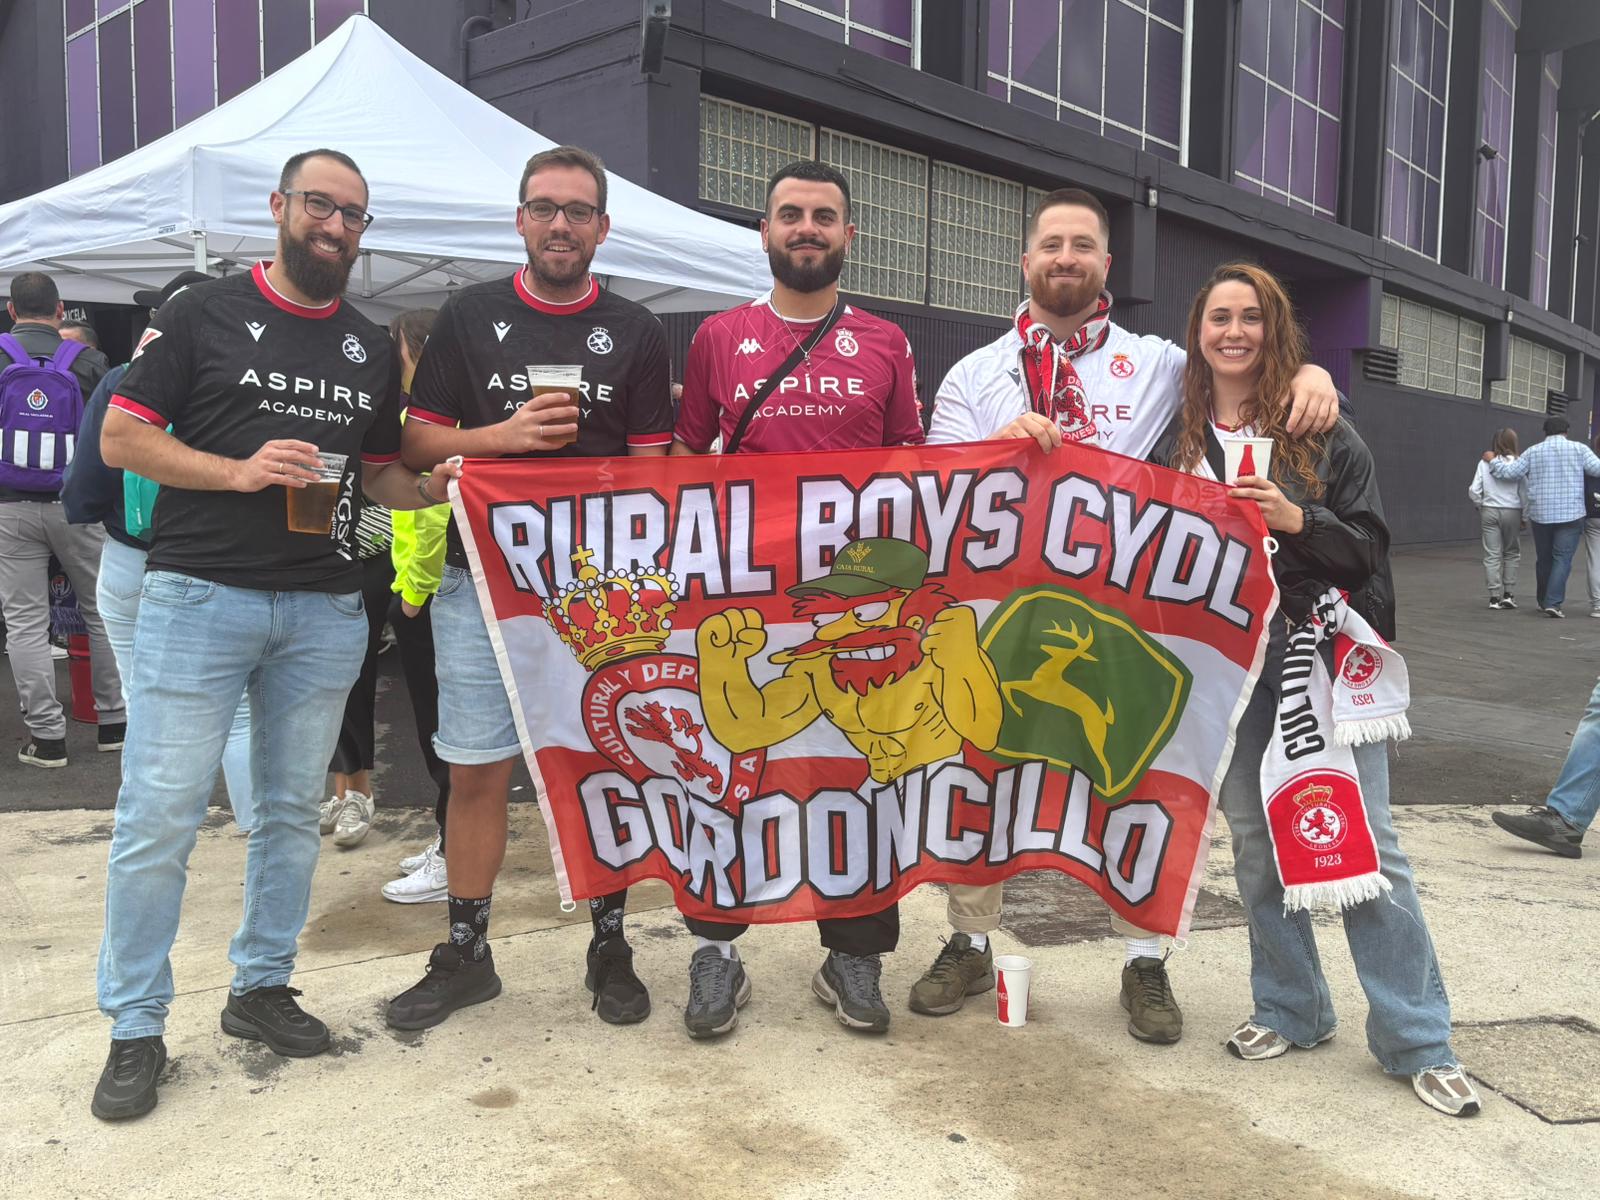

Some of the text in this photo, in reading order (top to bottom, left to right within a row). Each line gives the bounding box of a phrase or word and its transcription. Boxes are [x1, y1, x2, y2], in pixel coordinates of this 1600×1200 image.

[239, 368, 372, 411] ASPIRE
[487, 373, 613, 402] ASRE
[258, 399, 354, 426] ACADEMY
[752, 404, 846, 421] ACADEMY
[488, 482, 776, 601] RURAL
[797, 467, 1028, 585] BOYS
[1041, 471, 1254, 633] CYDL
[590, 677, 634, 766] CULTURAL
[617, 668, 633, 685] Y
[577, 759, 1174, 911] GORDONCILLO
[1314, 853, 1342, 869] 1923
